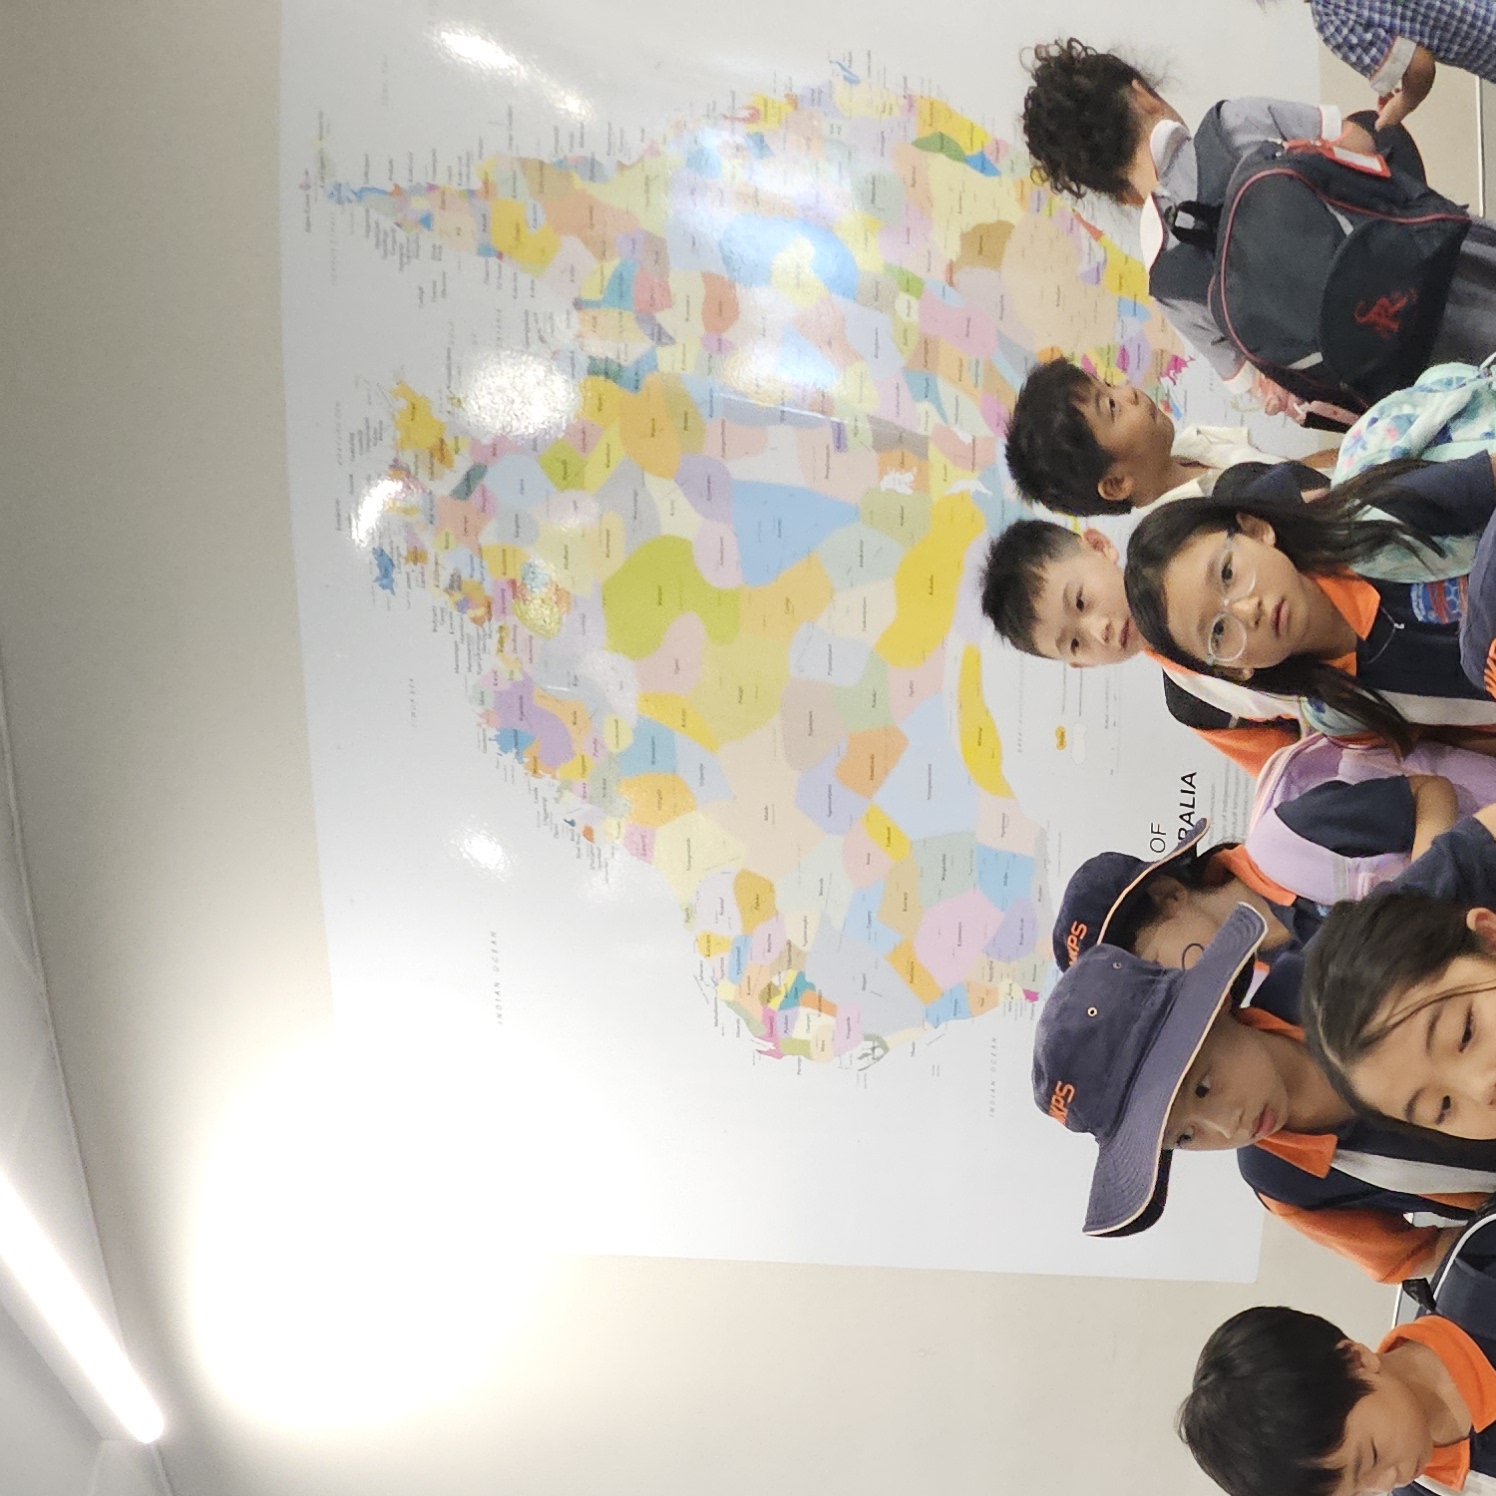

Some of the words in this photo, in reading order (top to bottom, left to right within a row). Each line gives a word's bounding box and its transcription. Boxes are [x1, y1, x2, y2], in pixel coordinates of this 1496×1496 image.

[1177, 771, 1197, 842] RALIA
[1149, 822, 1167, 854] OF
[490, 930, 500, 972] OCEAN
[492, 981, 503, 1025] INDIAN
[989, 1036, 998, 1073] OCEAN
